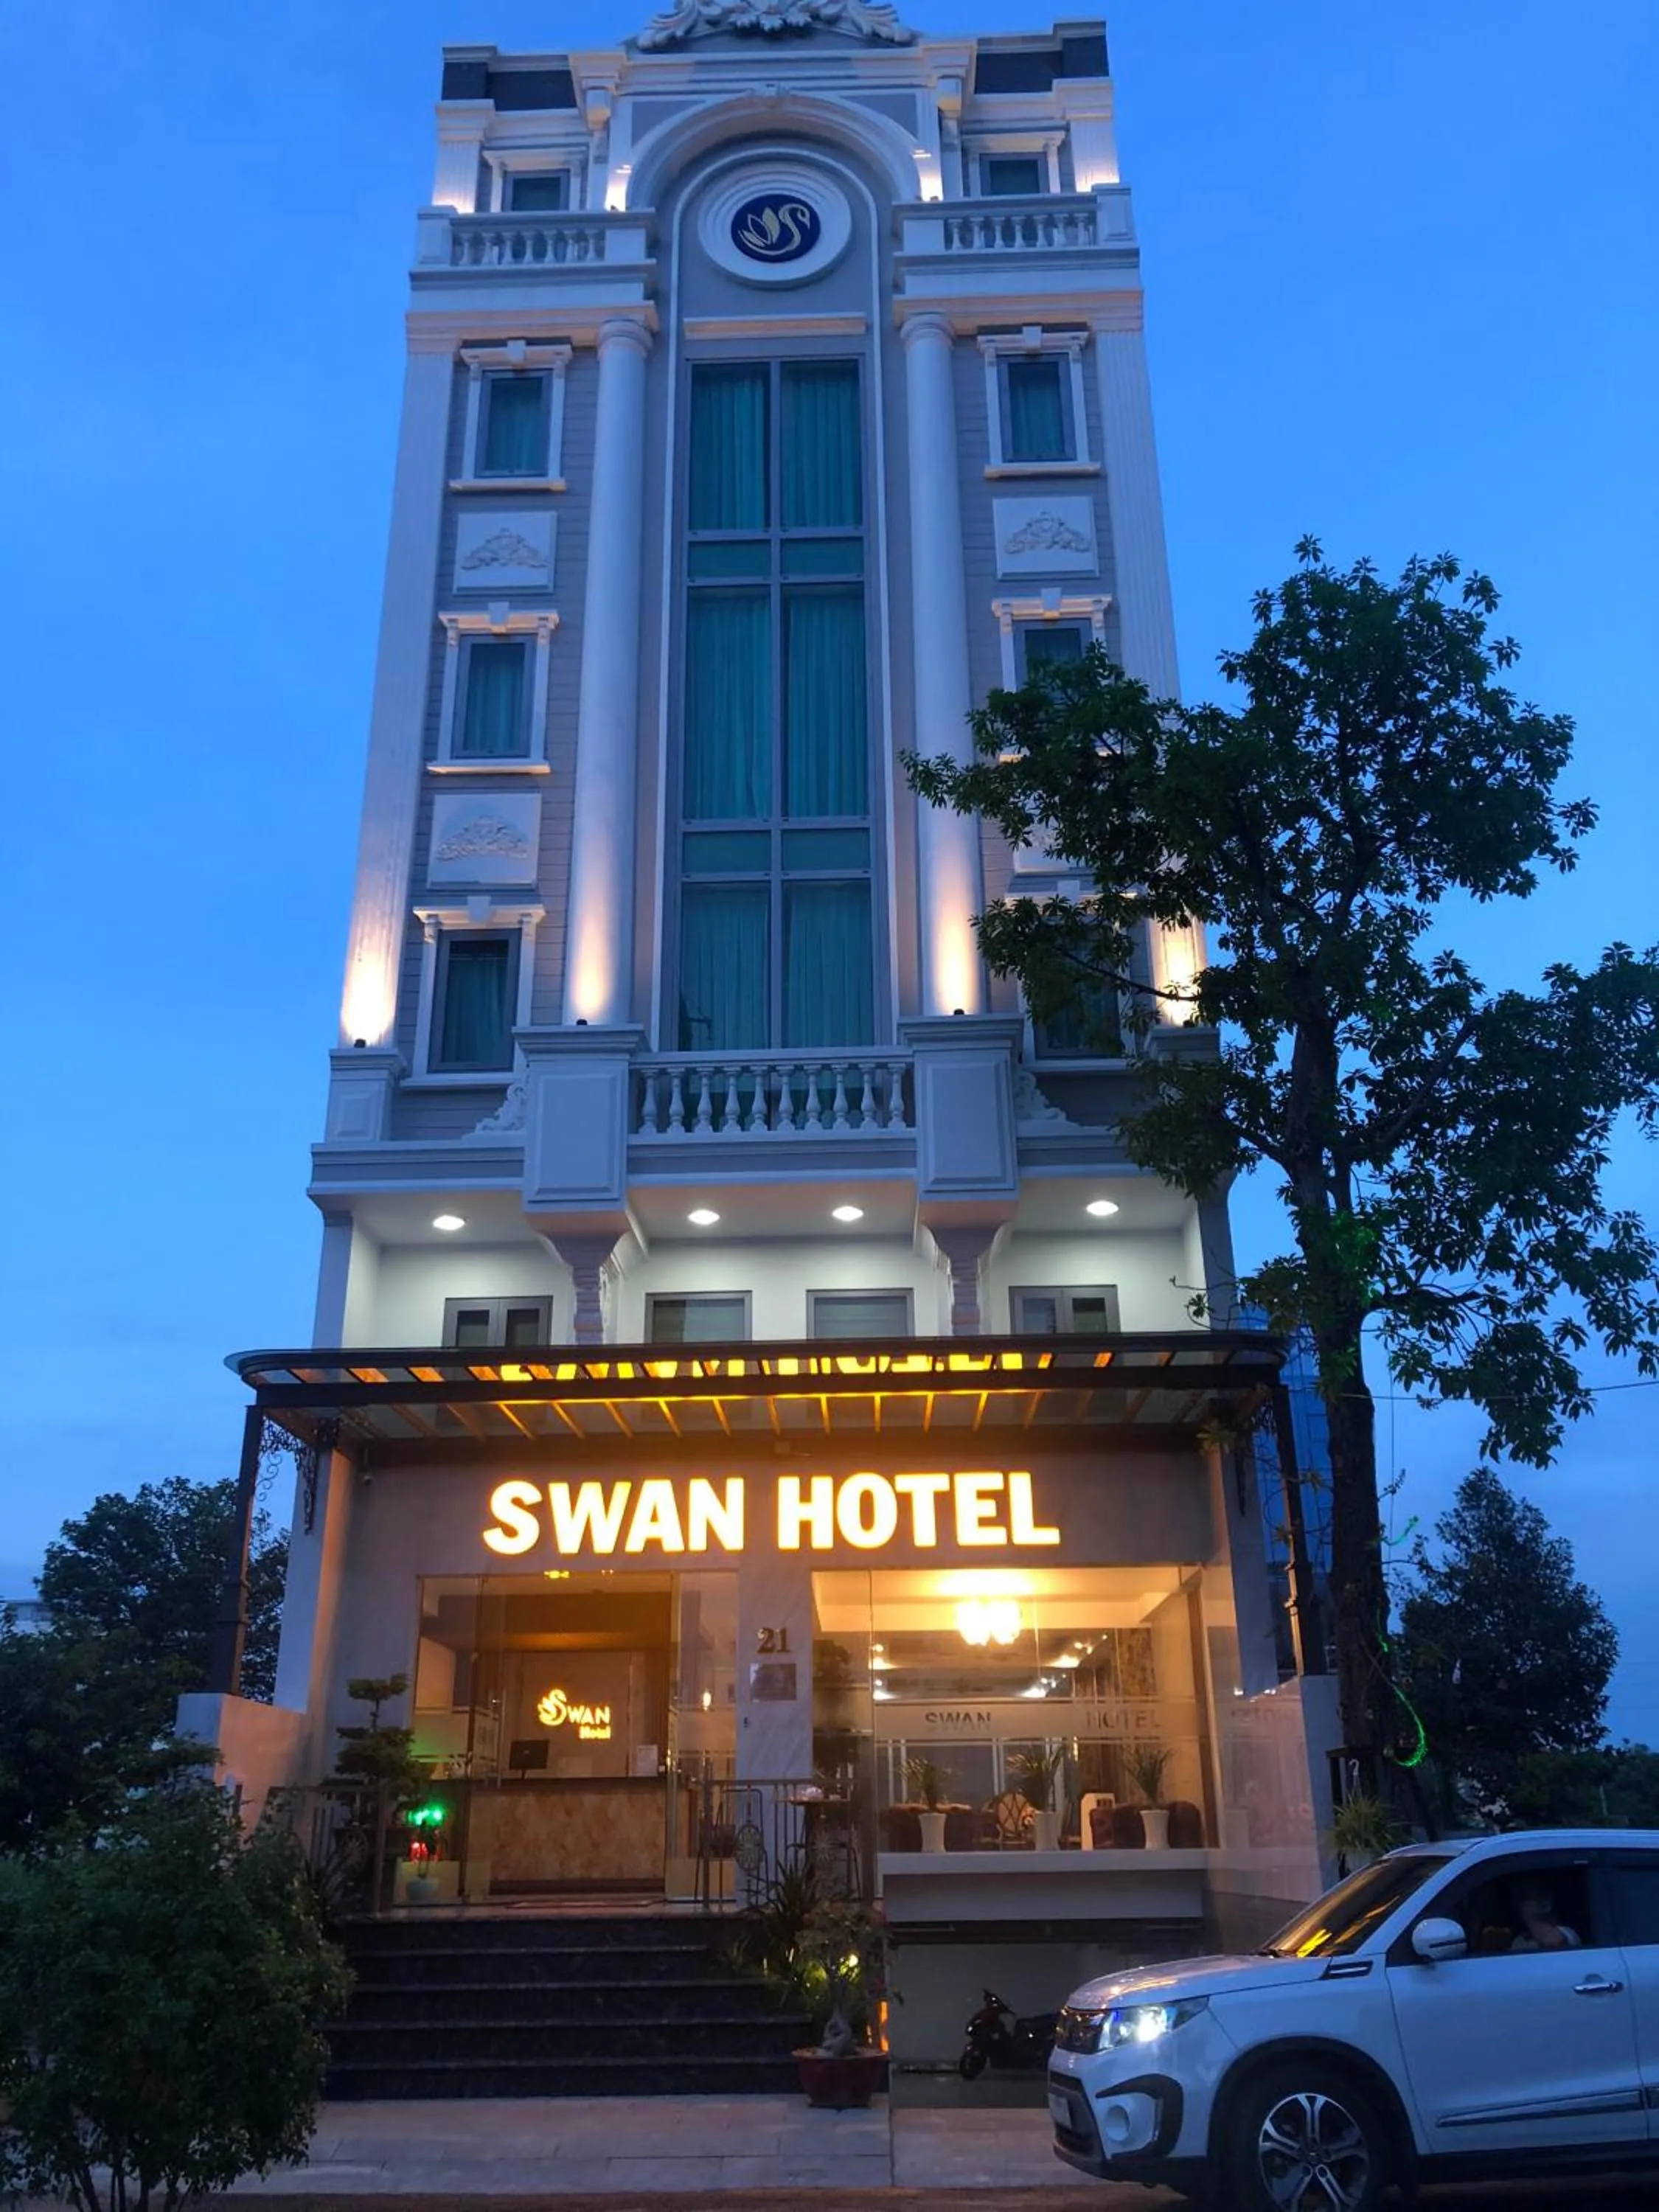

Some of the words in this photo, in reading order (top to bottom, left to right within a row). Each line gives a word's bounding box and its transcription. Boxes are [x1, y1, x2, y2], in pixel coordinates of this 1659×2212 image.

[483, 1478, 744, 1554] SWAN
[778, 1472, 1060, 1549] HOTEL
[757, 1627, 790, 1654] 21
[925, 1711, 991, 1731] SWAN
[1086, 1710, 1161, 1729] HOTEL
